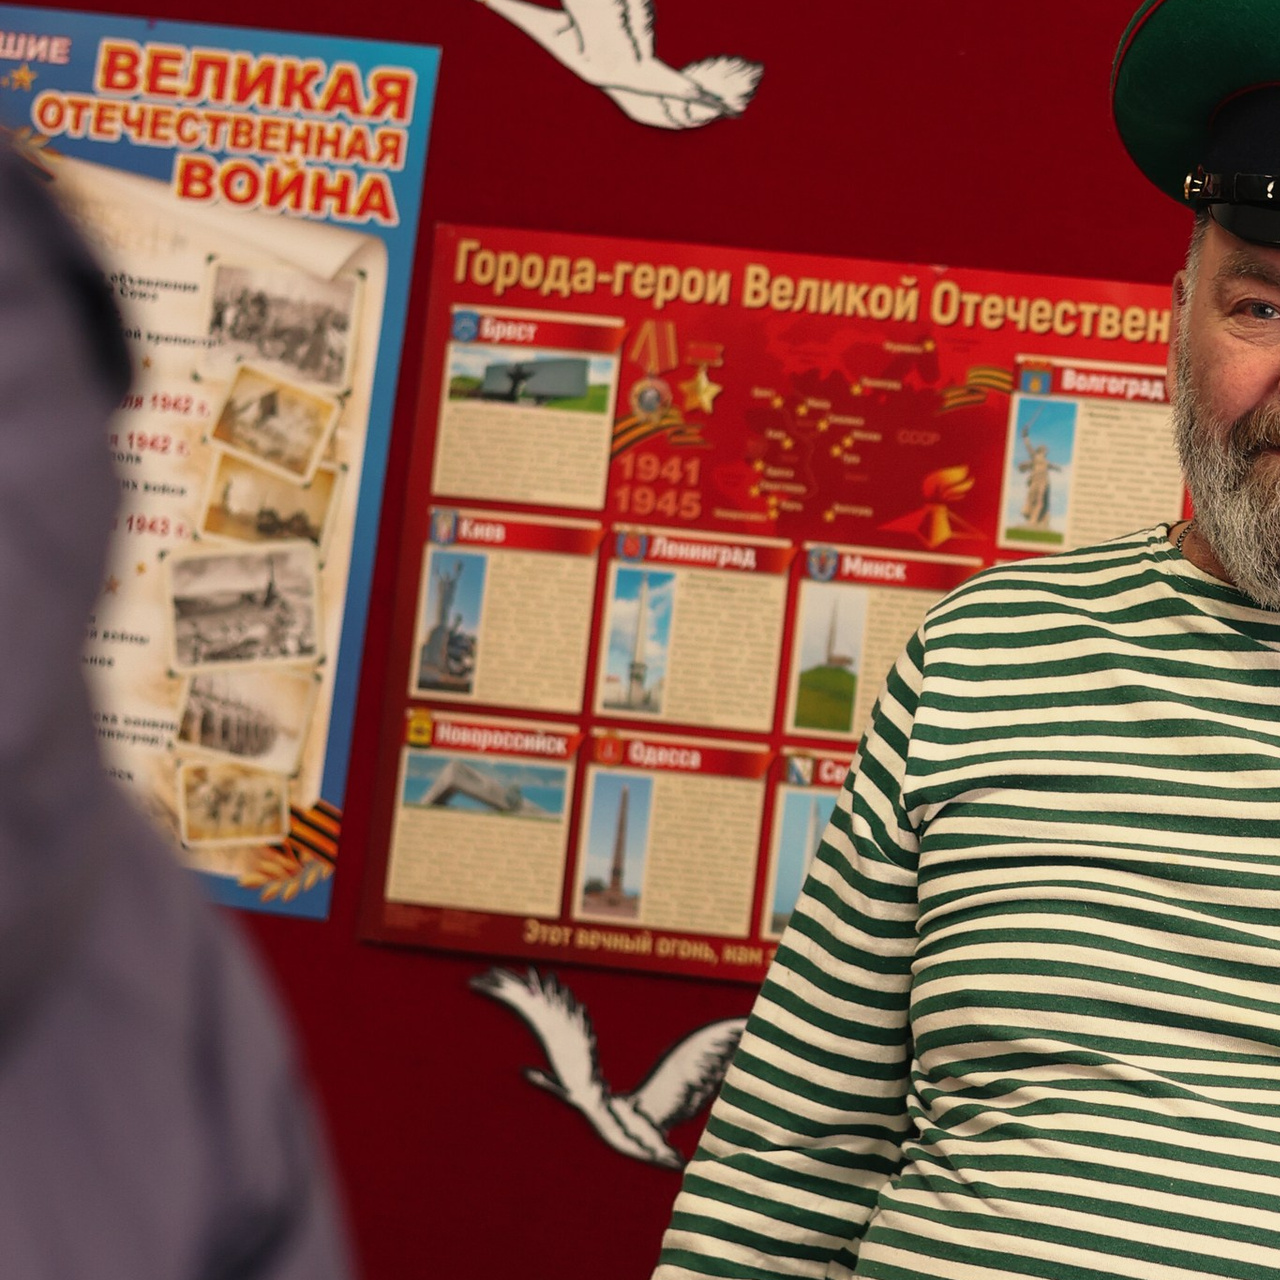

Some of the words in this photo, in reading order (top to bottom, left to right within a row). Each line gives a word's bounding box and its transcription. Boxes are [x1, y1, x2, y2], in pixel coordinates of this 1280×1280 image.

[97, 40, 415, 124] ВЕЛИКАЯ
[34, 91, 406, 169] ОТЕЧЕСТВЕННАЯ
[175, 153, 399, 225] ВОЙНА
[454, 238, 731, 309] Города-герои
[743, 263, 920, 323] Великой
[480, 316, 538, 342] Брест
[1062, 368, 1167, 400] Волгоград
[619, 453, 700, 485] 1941
[615, 483, 701, 519] 1945
[649, 536, 758, 569] Ленинград
[841, 555, 907, 581] Минск
[434, 721, 568, 756] Новороссийск
[629, 739, 702, 770] Одесса
[523, 919, 571, 946] Этот
[574, 926, 653, 956] вечный
[656, 936, 719, 965] огонь,
